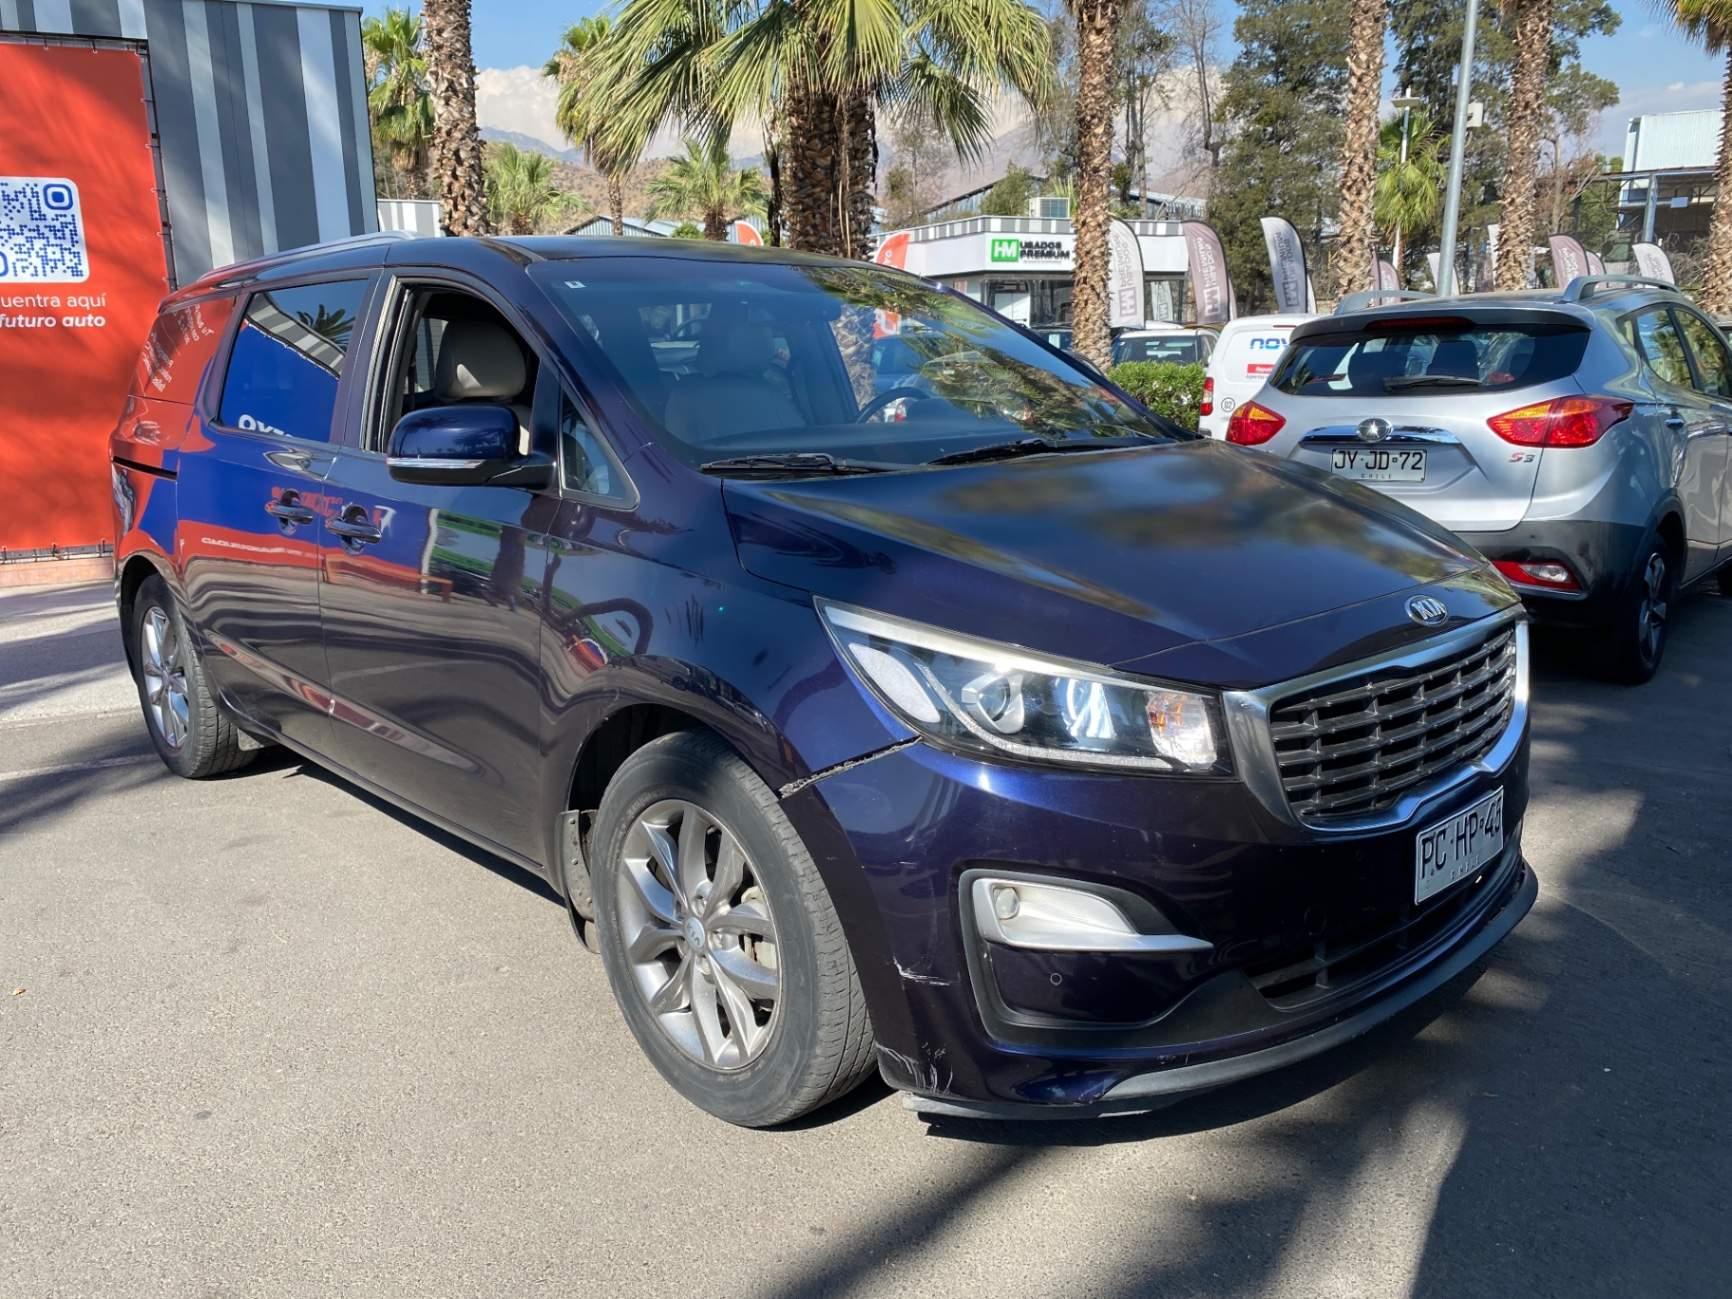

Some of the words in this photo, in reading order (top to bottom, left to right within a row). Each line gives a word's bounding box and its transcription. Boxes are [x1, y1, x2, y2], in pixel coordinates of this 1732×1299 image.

[992, 241, 1018, 259] HM
[1020, 241, 1062, 249] USADOS
[1020, 249, 1070, 259] PREMIUM
[67, 292, 106, 310] aquí
[0, 313, 57, 328] futuro
[62, 313, 106, 327] auto
[1509, 452, 1536, 463] S3
[1411, 599, 1446, 620] KIA
